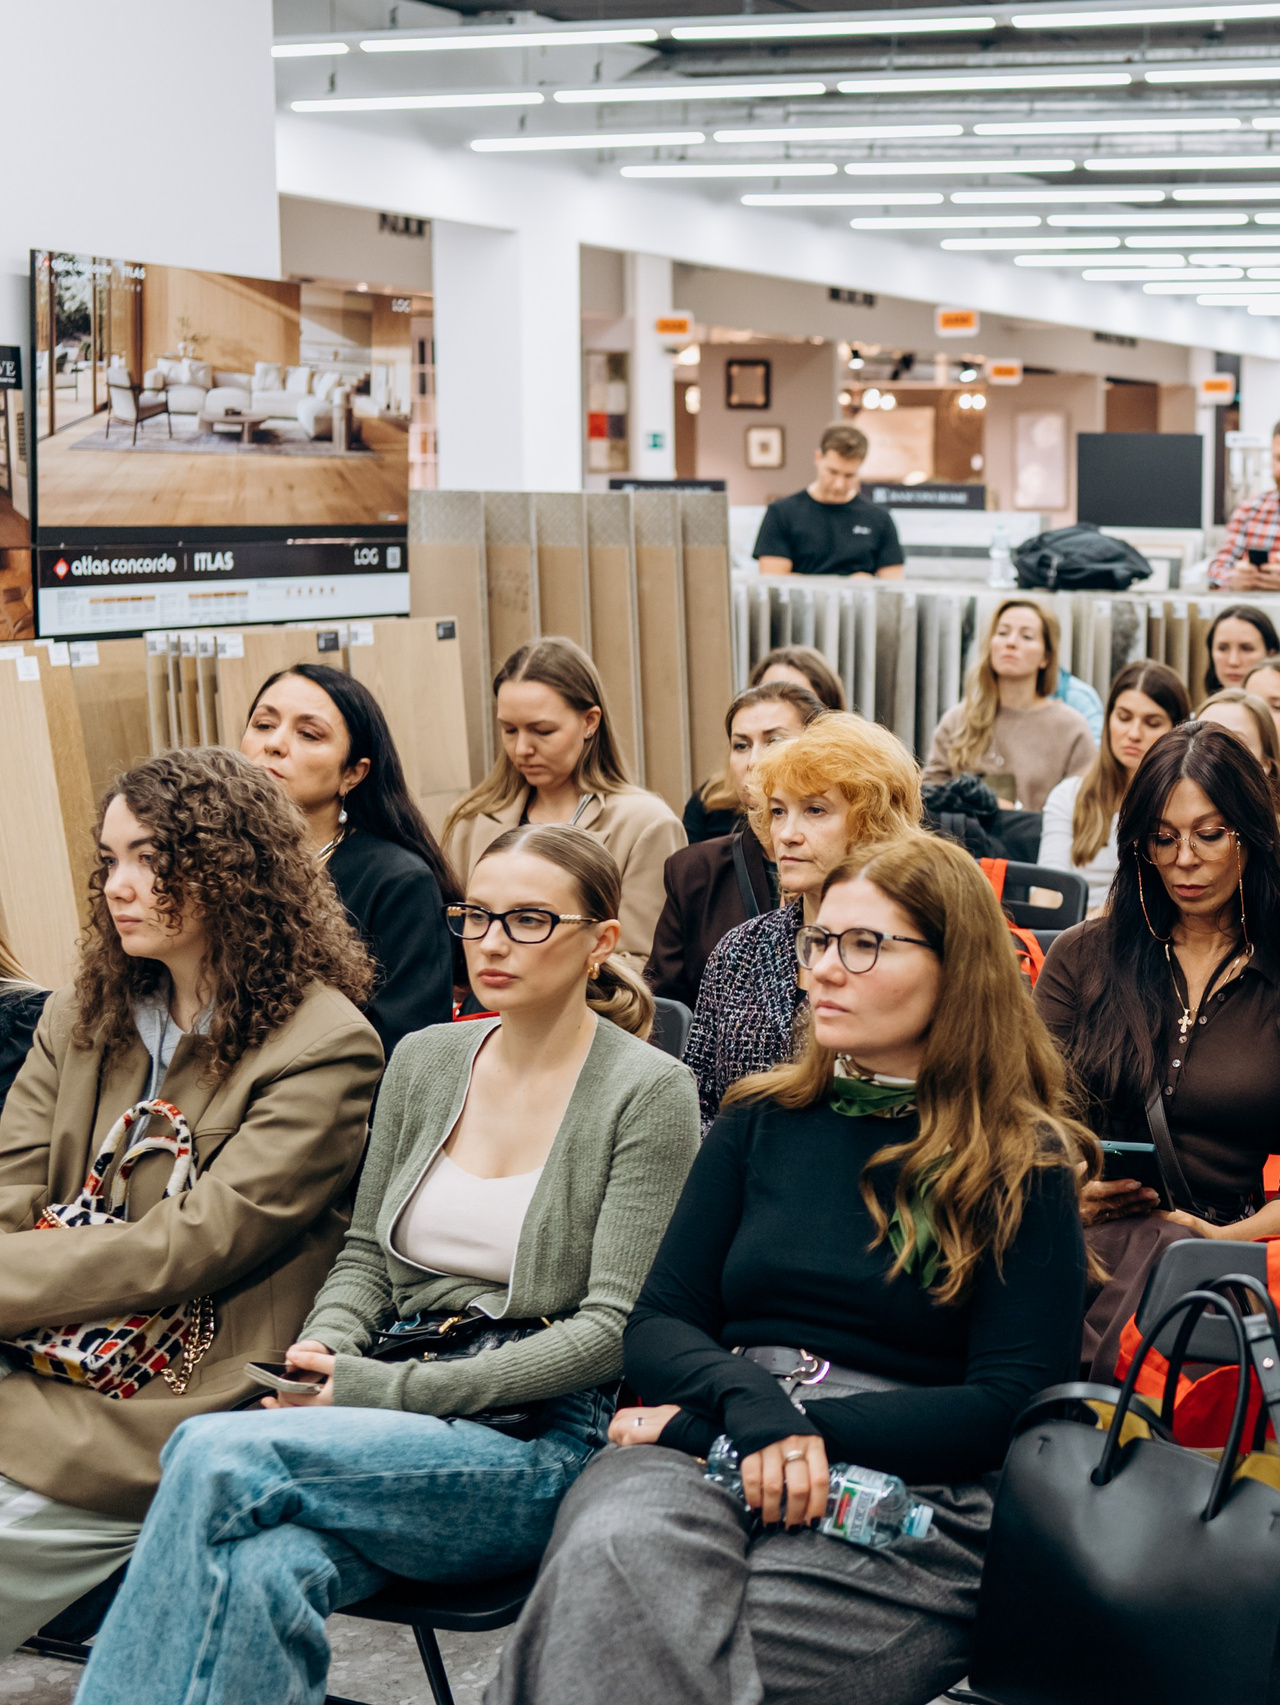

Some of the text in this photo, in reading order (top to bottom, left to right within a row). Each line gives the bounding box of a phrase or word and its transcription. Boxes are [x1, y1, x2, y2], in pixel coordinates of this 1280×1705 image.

[71, 551, 234, 576] atlas concorde ITLAS
[354, 547, 379, 566] LOG
